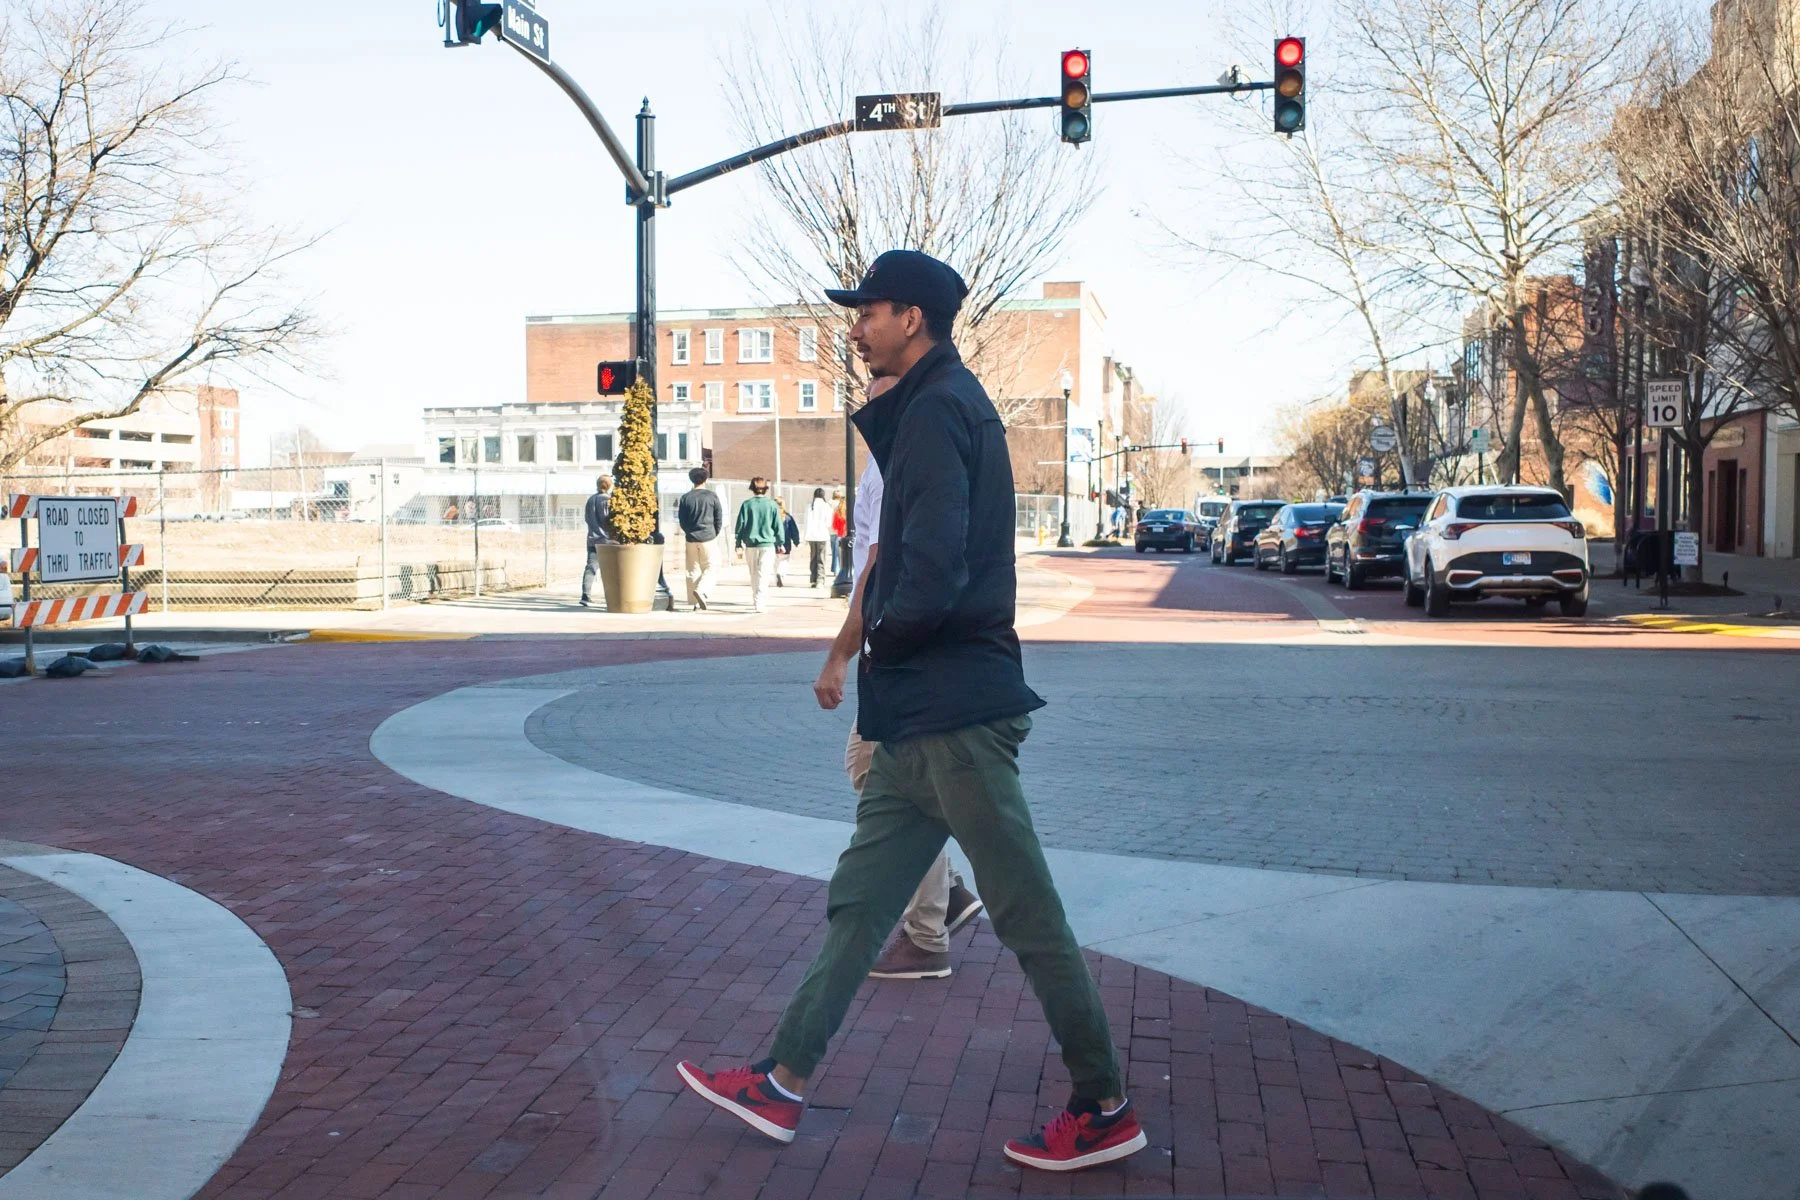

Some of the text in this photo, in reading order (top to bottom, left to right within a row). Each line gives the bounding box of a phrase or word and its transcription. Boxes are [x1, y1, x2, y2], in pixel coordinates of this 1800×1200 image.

[508, 5, 545, 50] Main St
[869, 101, 927, 122] 4TH St
[1649, 384, 1682, 393] SPEED
[1652, 405, 1677, 422] 10
[46, 507, 109, 526] ROAD CLOSED
[74, 530, 84, 547] TO
[46, 551, 113, 573] THRU TRAFFIC
